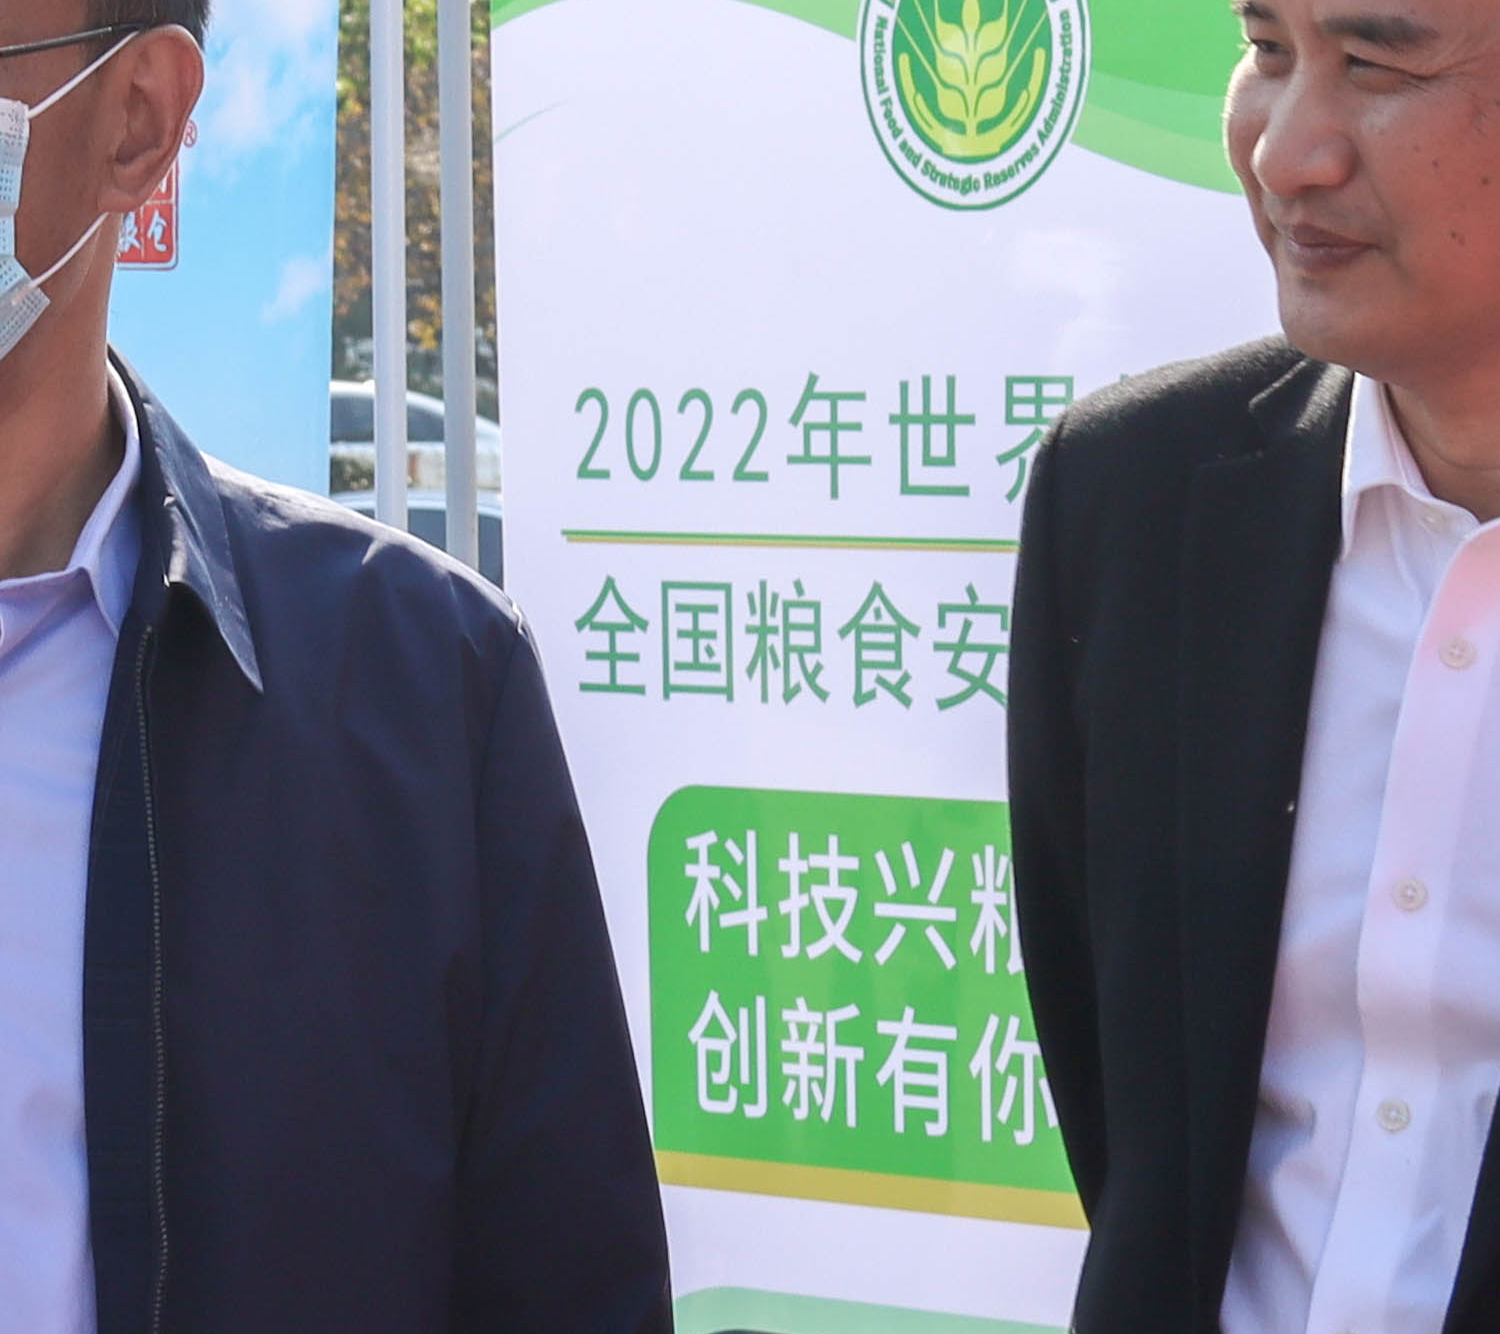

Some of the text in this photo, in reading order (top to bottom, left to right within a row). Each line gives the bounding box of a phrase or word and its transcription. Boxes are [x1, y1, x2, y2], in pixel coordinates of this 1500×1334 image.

[873, 9, 1073, 195] National Food and Strategic Reserves Administration
[574, 372, 1127, 504] 2022年世界
[574, 574, 1012, 711] 全国粮食安
[687, 989, 1059, 1146] 创新有你
